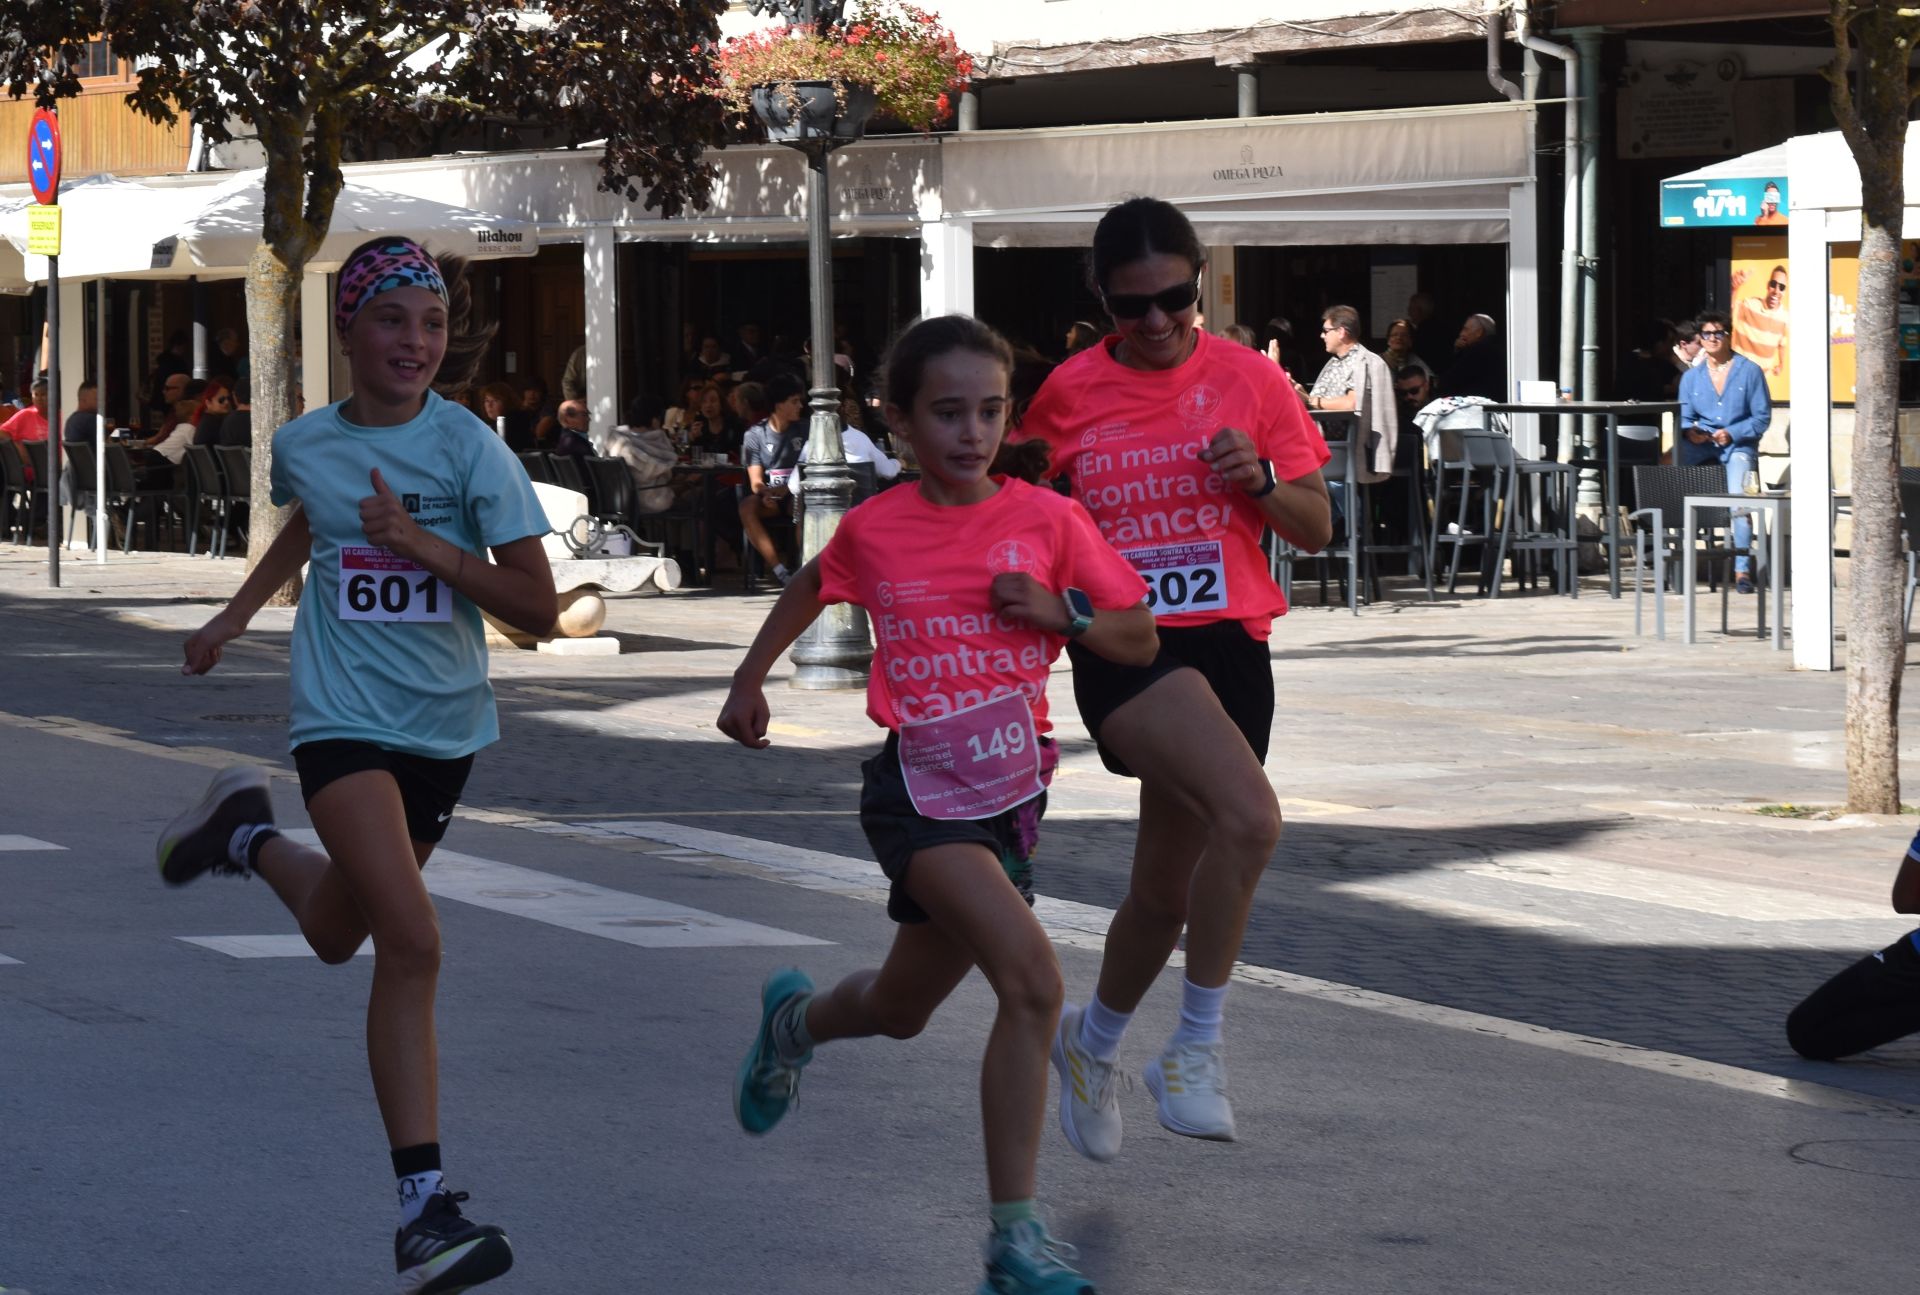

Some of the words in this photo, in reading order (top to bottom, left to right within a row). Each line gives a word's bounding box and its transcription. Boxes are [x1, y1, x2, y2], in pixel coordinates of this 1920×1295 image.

[1213, 168, 1250, 181] OMEGA
[1253, 165, 1283, 179] PLAZA
[478, 229, 522, 243] Mahou
[1082, 451, 1112, 477] En
[1086, 473, 1198, 510] contra
[343, 548, 351, 556] VI
[352, 548, 382, 557] CARRERA
[1129, 550, 1158, 559] CARRERA
[348, 574, 438, 613] 601
[885, 614, 917, 641] En
[889, 644, 1016, 682] contra
[1020, 636, 1050, 670] el
[919, 742, 951, 754] marcha
[967, 722, 1026, 763] 149
[910, 753, 941, 764] contra
[917, 791, 942, 803] Aguilar
[943, 788, 954, 798] de
